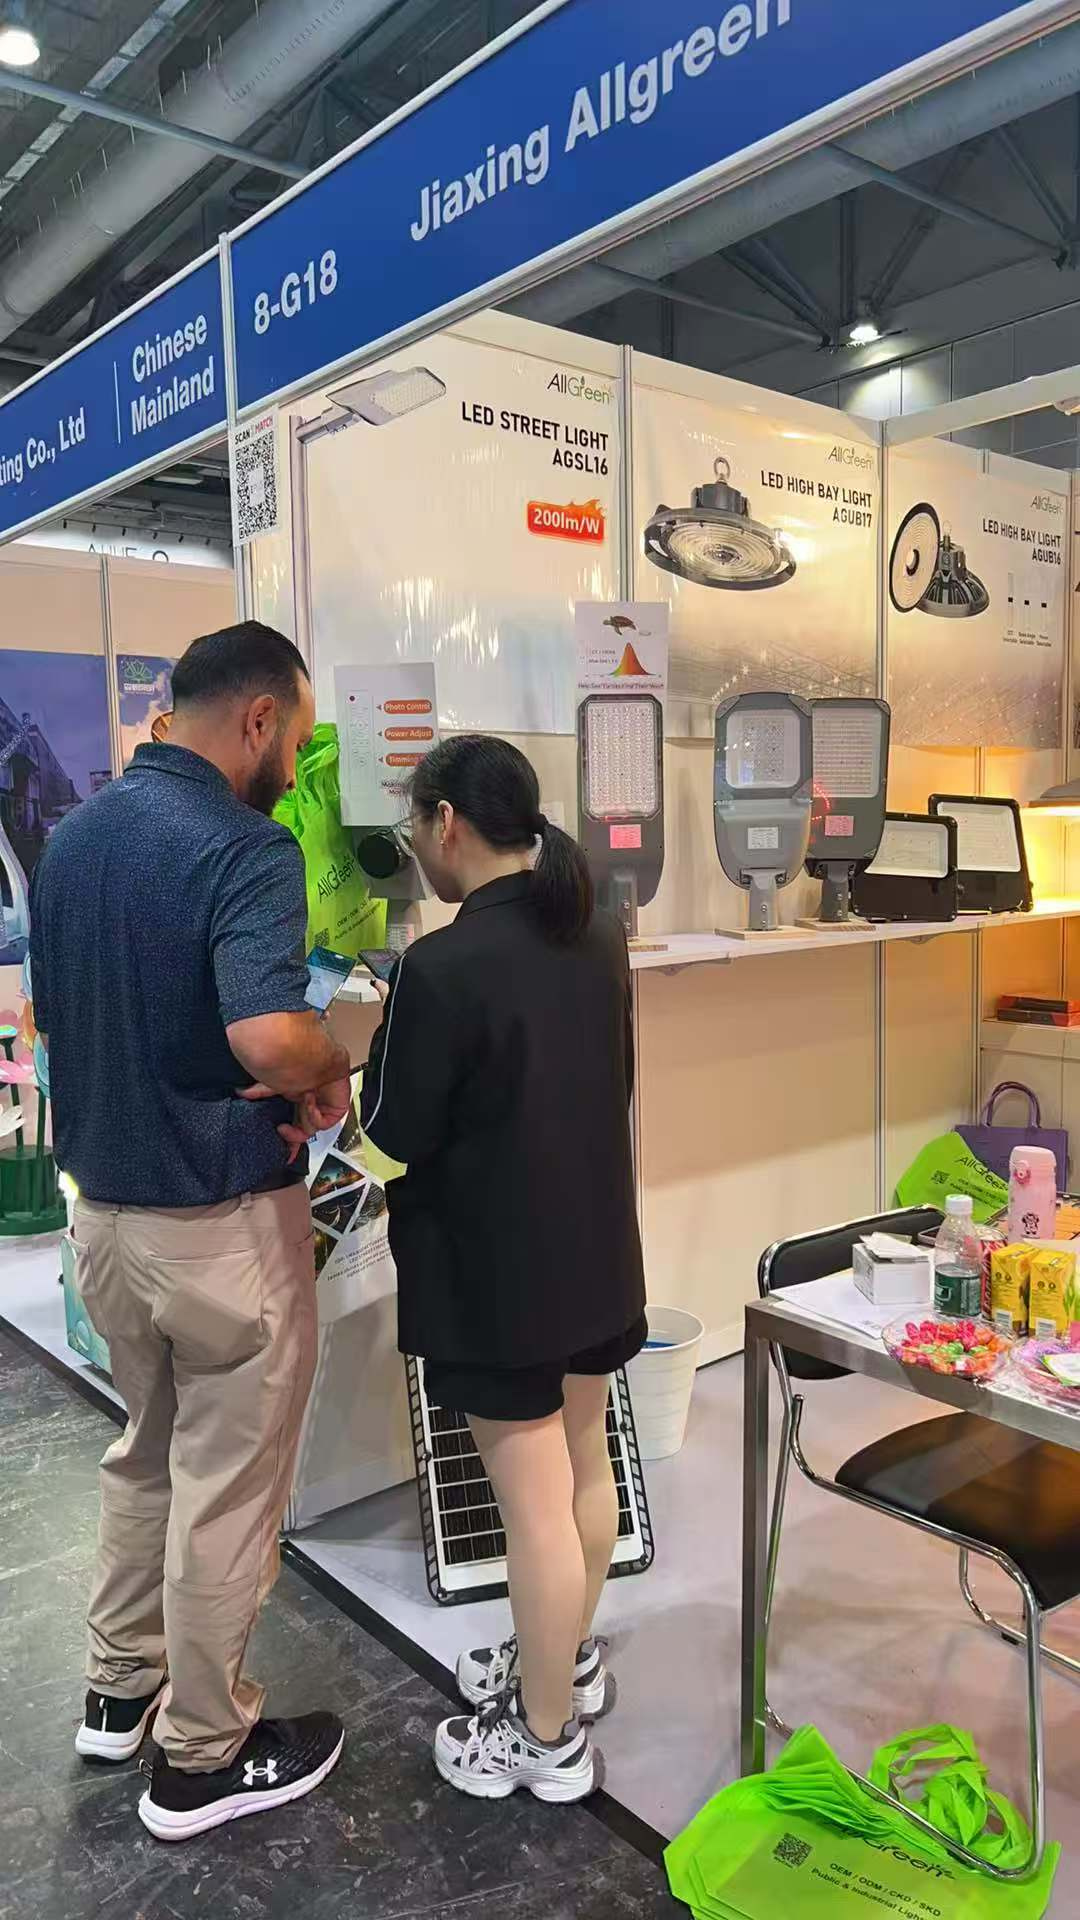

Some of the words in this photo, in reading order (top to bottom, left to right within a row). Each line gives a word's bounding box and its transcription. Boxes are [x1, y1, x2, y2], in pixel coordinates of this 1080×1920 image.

[410, 125, 550, 241] Jiaxing
[565, 0, 791, 153] Allgreen
[254, 249, 338, 335] 8-G18
[132, 315, 208, 383] Chinese
[131, 355, 215, 435] Mainland
[547, 373, 610, 404] AllGreen
[26, 438, 56, 469] Co.,
[59, 407, 86, 451] Ltd
[462, 401, 494, 426] LED
[500, 411, 560, 441] STREET
[565, 425, 609, 451] LIGHT
[552, 448, 609, 476] AGSL16
[828, 446, 873, 470] AllGreen
[761, 470, 783, 489] LED
[787, 475, 815, 497] HIGH
[818, 483, 840, 501] BAY
[842, 488, 873, 508] LIGHT
[533, 508, 600, 535] 200lm/W
[833, 507, 873, 528] AGUB17
[982, 518, 999, 535] LED
[1001, 523, 1019, 541] HIGH
[1020, 528, 1036, 544] BAY
[1038, 531, 1062, 548] LIGHT
[1032, 548, 1062, 566] AGUB16
[385, 703, 405, 712] Photo
[406, 702, 431, 711] Control
[387, 730, 408, 738] Power
[409, 729, 432, 739] Adjust
[811, 1867, 841, 1886] Public
[851, 1886, 898, 1910] Industrial
[830, 1862, 853, 1877] OEM
[858, 1876, 883, 1891] ODM
[889, 1889, 912, 1903] CKD
[919, 1902, 942, 1917] SKD
